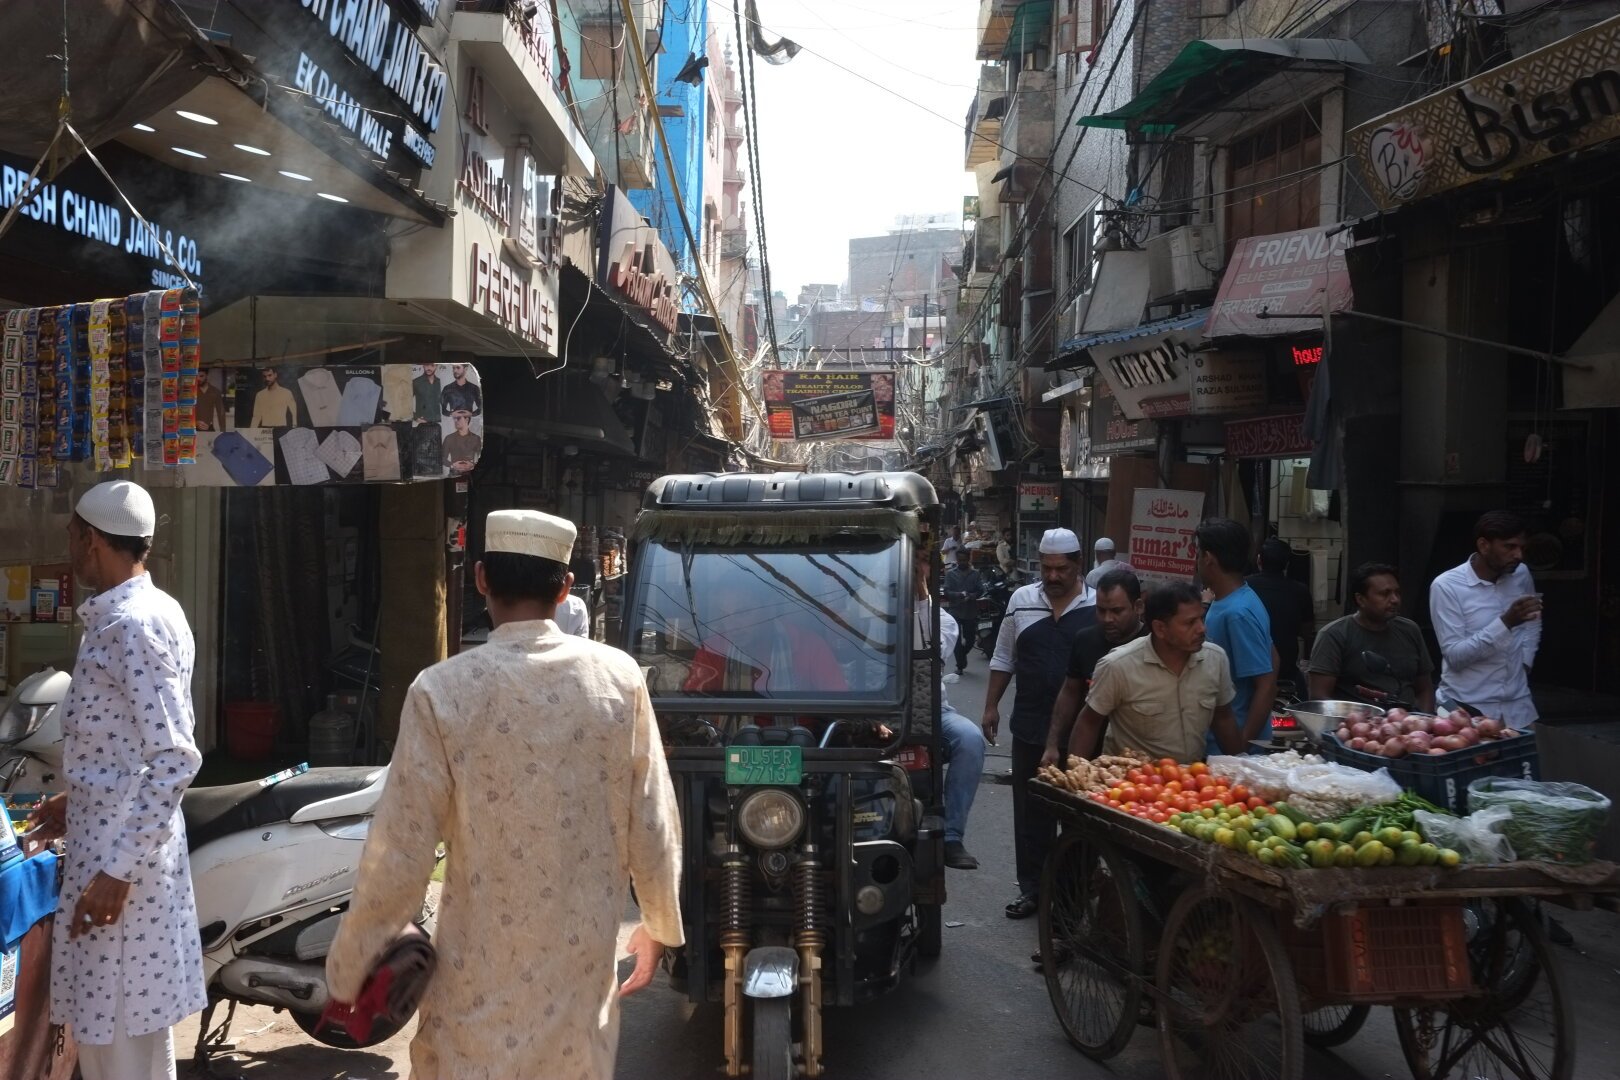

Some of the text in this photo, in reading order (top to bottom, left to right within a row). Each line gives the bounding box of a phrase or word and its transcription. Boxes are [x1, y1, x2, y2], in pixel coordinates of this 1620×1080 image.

[383, 22, 421, 105] JAIN
[413, 51, 429, 116] &
[295, 52, 393, 160] EK DAAM WALE
[0, 164, 57, 226] RESH
[62, 189, 121, 247] CHAND
[125, 217, 160, 260] JAIN
[1249, 227, 1354, 269] FRIENDS
[1236, 268, 1289, 285] GUEST
[1196, 373, 1232, 383] ARSHAD
[1018, 485, 1057, 496] CHEMIST
[1132, 536, 1197, 559] umar's
[1133, 557, 1147, 566] The
[1147, 558, 1167, 568] Hijab
